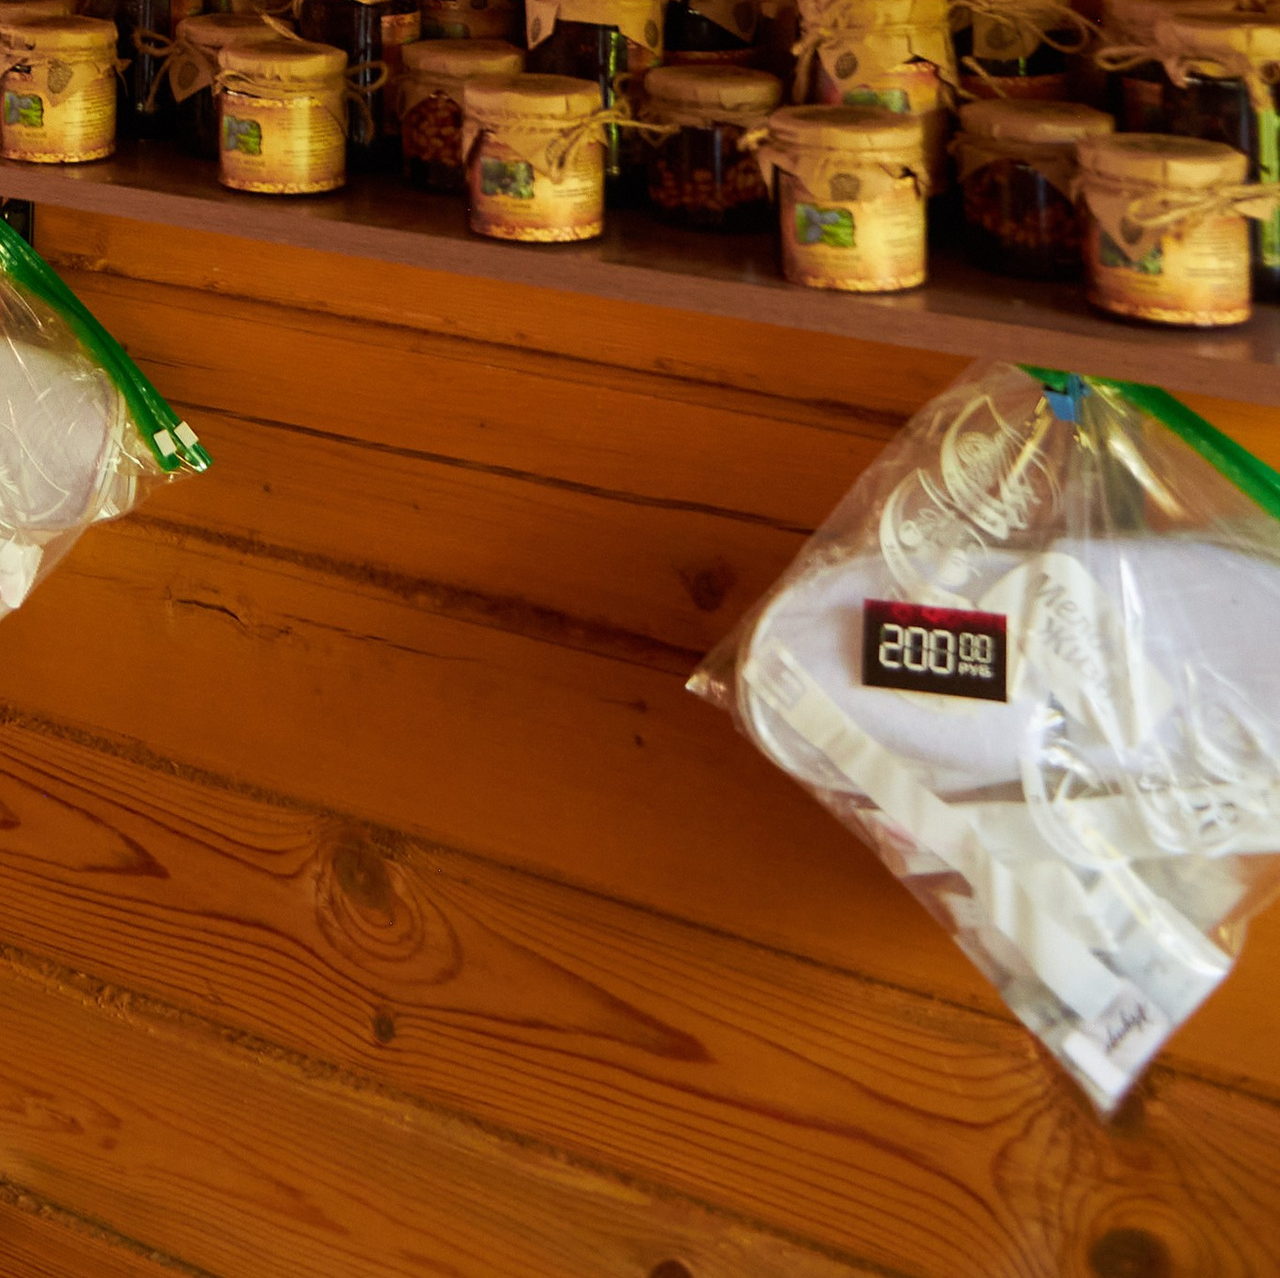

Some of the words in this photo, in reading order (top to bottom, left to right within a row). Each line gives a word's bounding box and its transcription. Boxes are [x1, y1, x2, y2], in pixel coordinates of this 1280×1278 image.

[878, 623, 957, 676] 200
[958, 631, 994, 664] 00
[958, 664, 994, 679] РУБ
